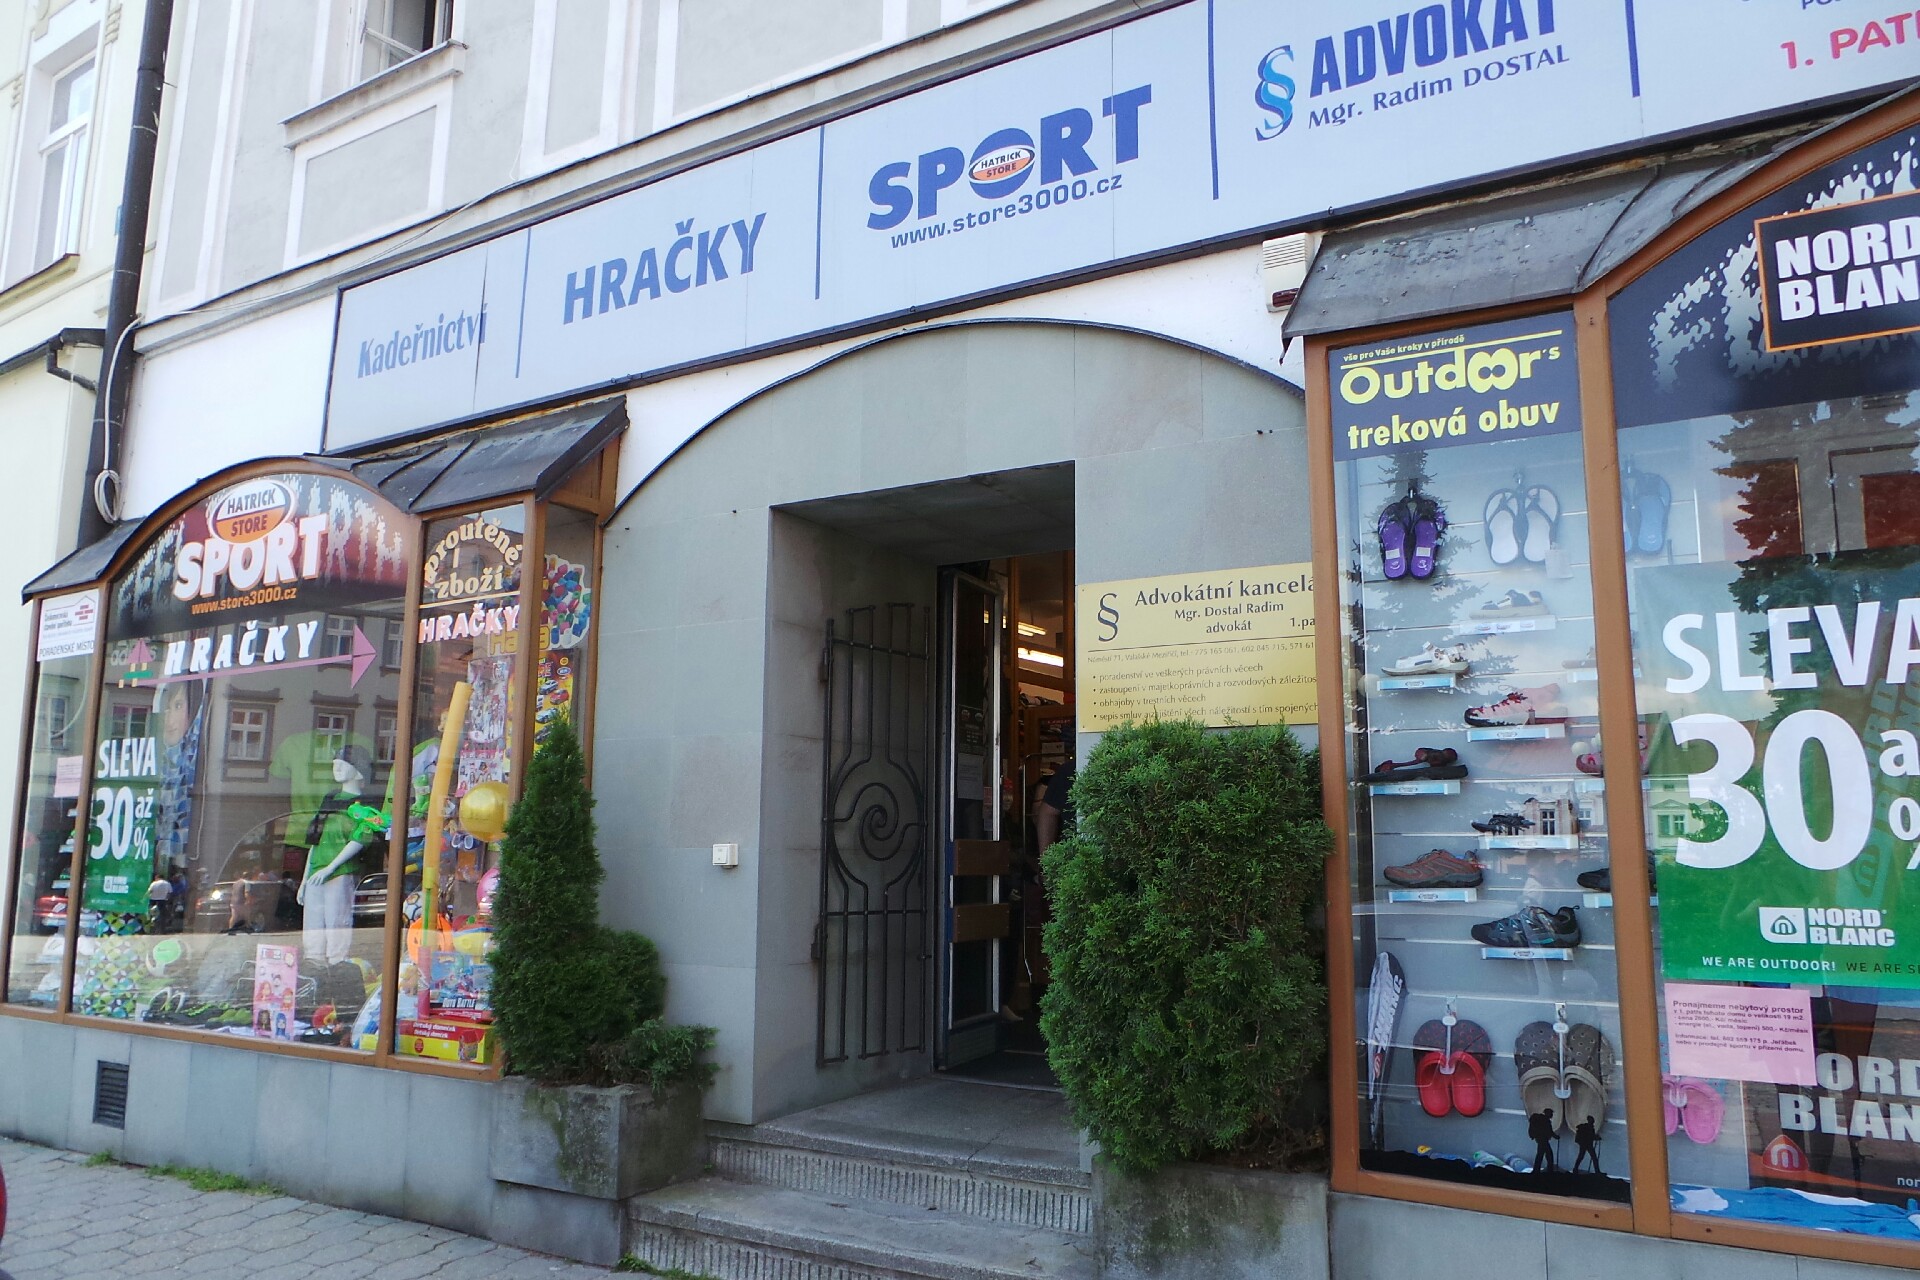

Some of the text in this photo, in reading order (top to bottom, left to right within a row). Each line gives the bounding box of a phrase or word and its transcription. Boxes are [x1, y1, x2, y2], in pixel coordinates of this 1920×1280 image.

[1780, 10, 1920, 69] 1. PAT
[1308, 44, 1570, 129] Mgr. Radim DOSTAL
[866, 83, 1152, 231] SPORT
[980, 149, 1023, 170] HATRICK
[986, 161, 1018, 178] STORE
[891, 174, 1123, 249] www.store3000.cz
[563, 213, 767, 325] HRAČKY
[357, 301, 488, 379] Kadeřnictví
[1343, 334, 1465, 362] vše pro Vaše kroky v přírodě
[1348, 399, 1560, 449] treková obuv
[227, 487, 276, 515] HATRICK
[231, 514, 268, 537] STORE
[173, 513, 329, 602] SPORT
[424, 516, 523, 585] proutěné
[435, 565, 503, 600] zboží
[1134, 581, 1234, 607] Advokátní
[191, 586, 297, 616] www.store3000.cz
[1174, 602, 1284, 622] Mgr. Dostal Radim
[418, 603, 520, 644] HRAČKY
[1205, 619, 1252, 634] advokát
[164, 619, 318, 676] HRAČKY
[1099, 671, 1143, 683] poradenství
[1155, 667, 1194, 678] veškerých
[1196, 665, 1232, 677] právních
[1234, 662, 1264, 673] věcech
[1099, 684, 1140, 695] zastoupení
[1148, 679, 1214, 693] majetkoprávních
[1223, 676, 1277, 688] rozvodových
[1099, 698, 1135, 709] obhajoby
[1143, 694, 1176, 705] trestních
[1177, 693, 1206, 703] věcech
[1099, 711, 1119, 722] sepis
[1120, 710, 1142, 719] smluv
[1184, 706, 1207, 716] všech
[1209, 705, 1251, 715] náležitostí
[1259, 704, 1273, 713] tím
[97, 737, 157, 779] SLEVA
[1671, 709, 1874, 871] 30
[90, 786, 155, 860] 30 až
[1808, 907, 1881, 927] NORD
[1809, 927, 1896, 947] BLANC
[1702, 956, 1723, 968] WE
[1728, 957, 1756, 969] ARE
[1760, 957, 1836, 972] OUTDOOR!
[1846, 962, 1868, 973] WE
[1873, 962, 1902, 975] ARE
[1673, 1000, 1726, 1009] Pronajmeme
[1729, 1004, 1769, 1013] nebytový
